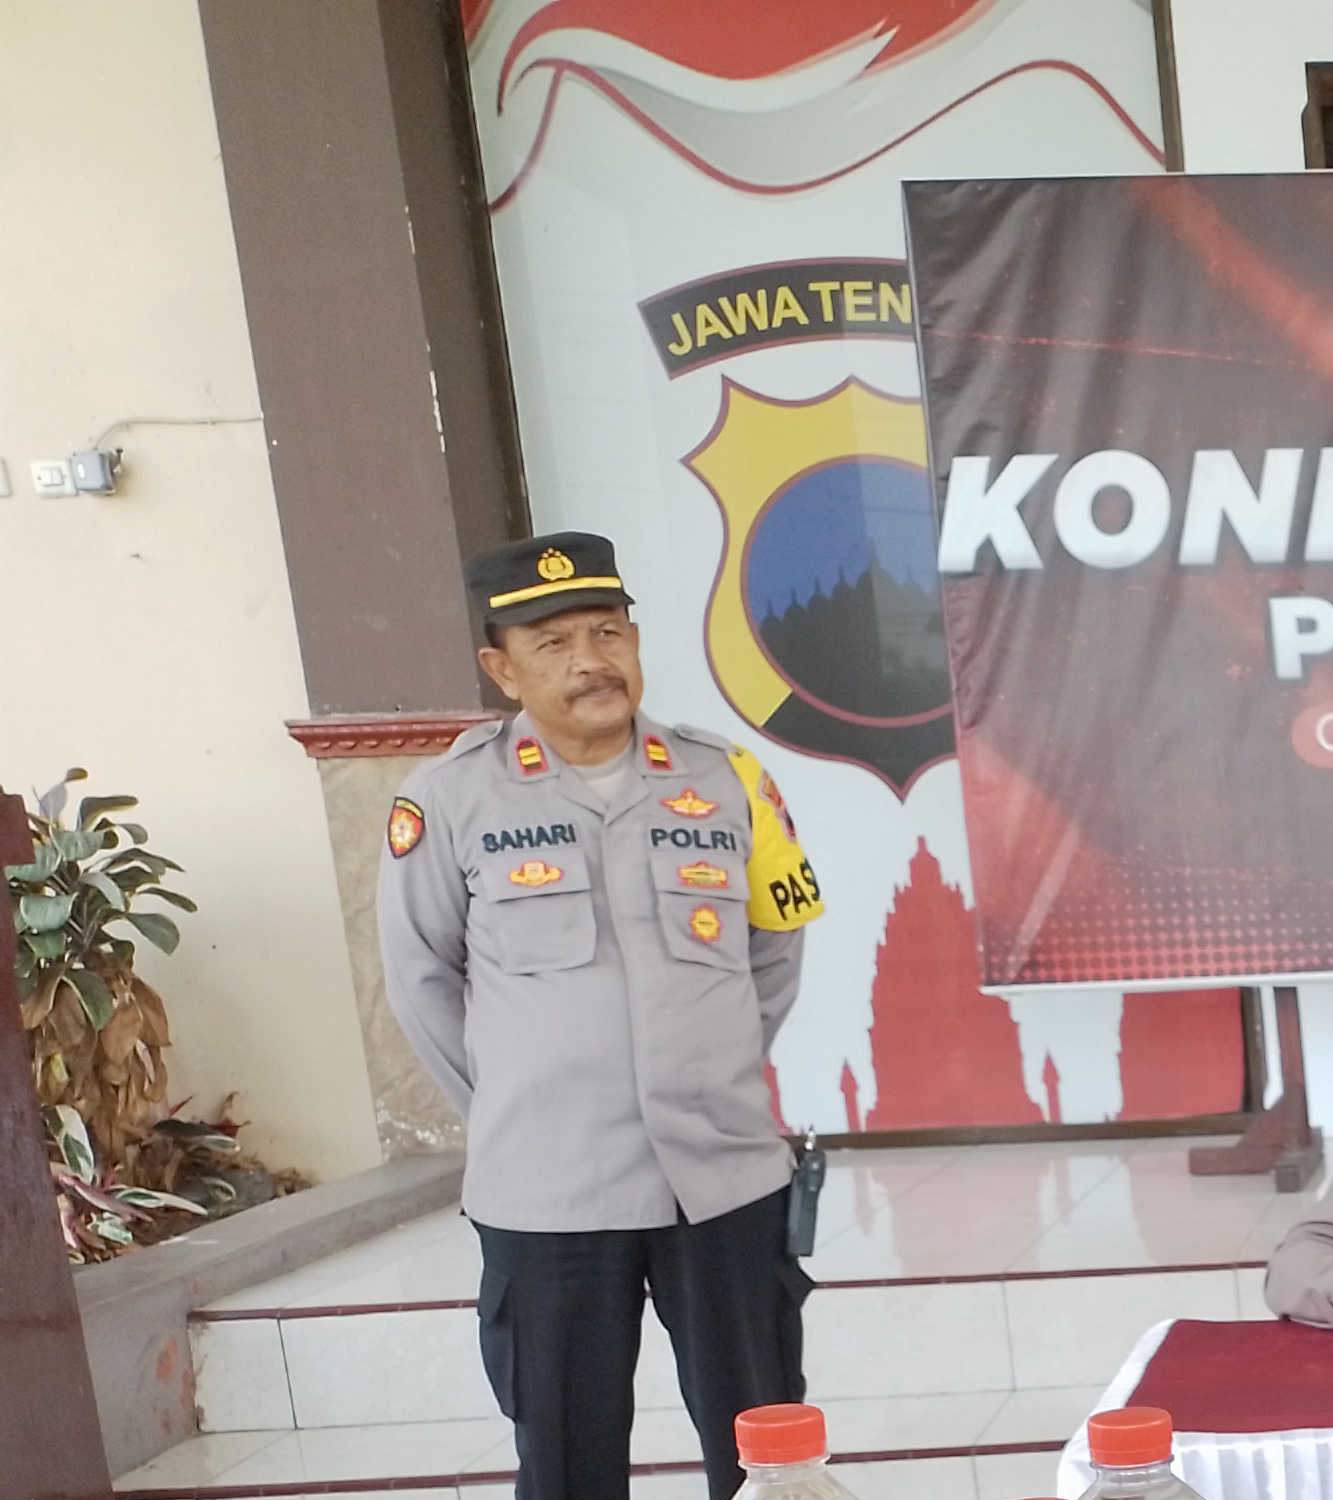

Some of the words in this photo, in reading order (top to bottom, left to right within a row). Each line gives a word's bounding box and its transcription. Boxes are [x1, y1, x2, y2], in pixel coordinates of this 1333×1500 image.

[667, 284, 808, 357] JAWA
[807, 280, 912, 323] TEN
[481, 823, 577, 855] SAHARI
[650, 828, 737, 853] POLRI
